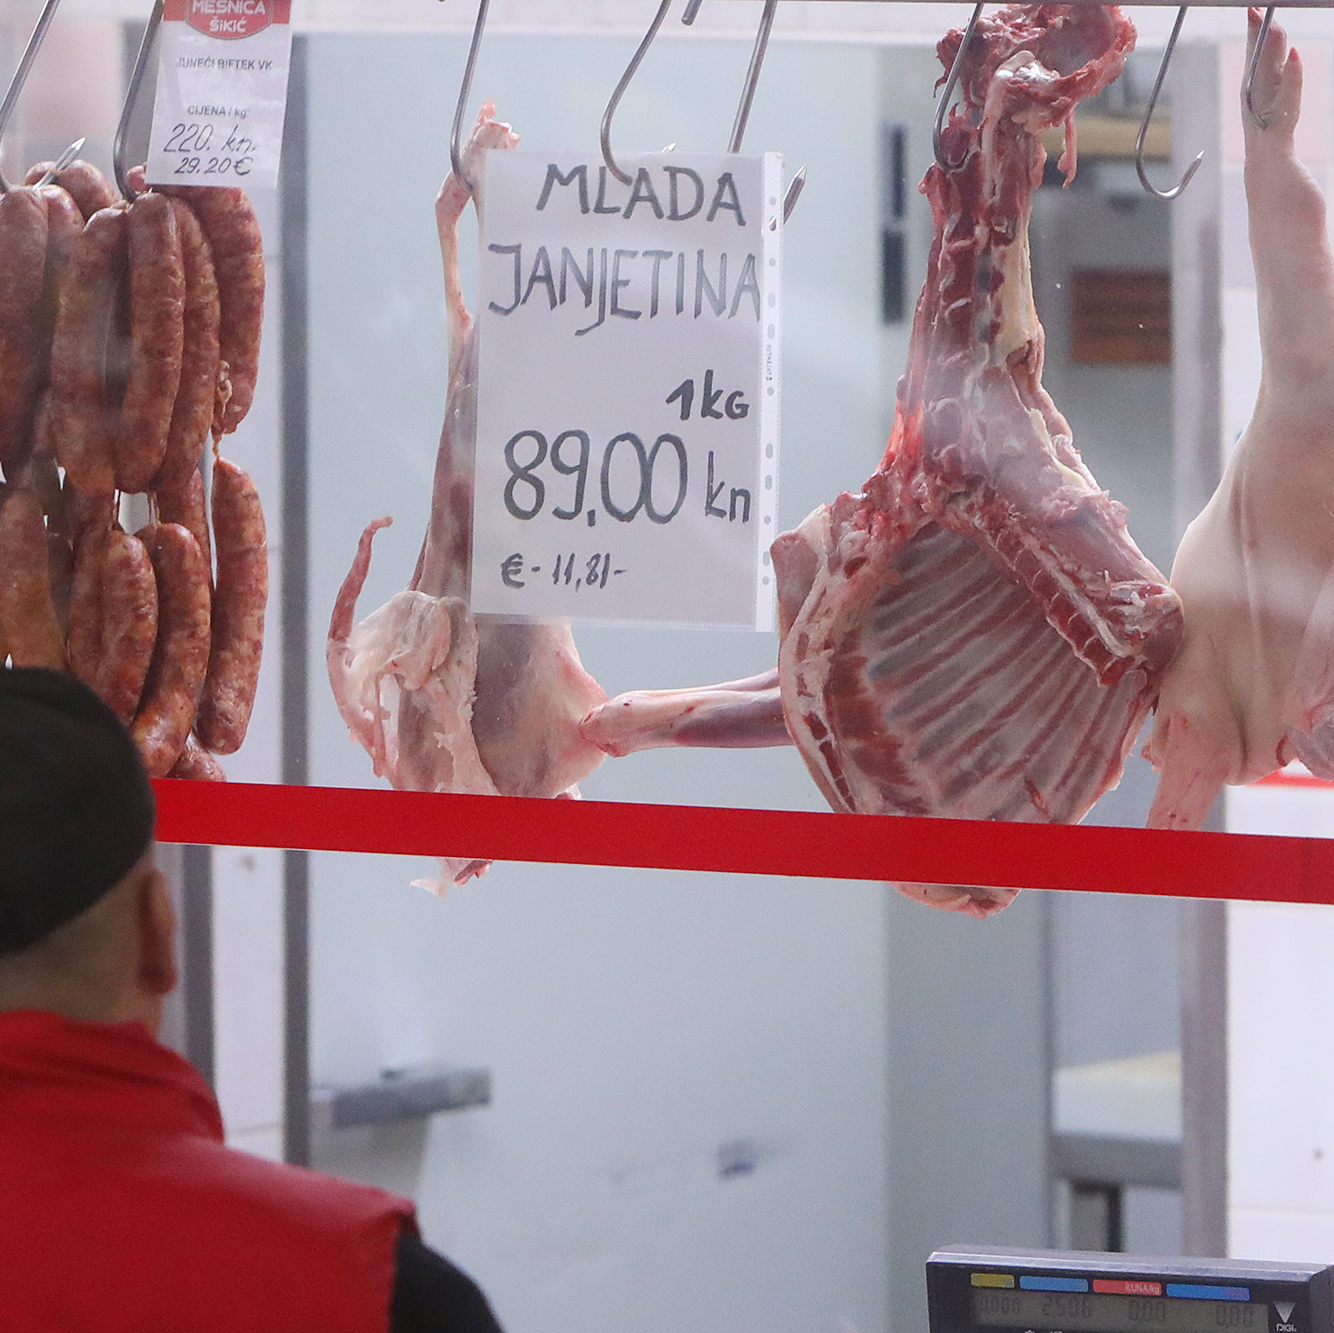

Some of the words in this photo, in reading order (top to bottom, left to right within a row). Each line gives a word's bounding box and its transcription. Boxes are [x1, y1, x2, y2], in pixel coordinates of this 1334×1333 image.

[192, 0, 266, 15] MESNICA
[217, 59, 255, 70] BIFTEK
[258, 60, 273, 70] VK
[188, 105, 226, 117] CIJENA
[535, 163, 747, 227] MLADA
[487, 242, 762, 337] JANJETINA
[704, 450, 752, 524] kn
[1124, 1282, 1161, 1296] KUNA/kg
